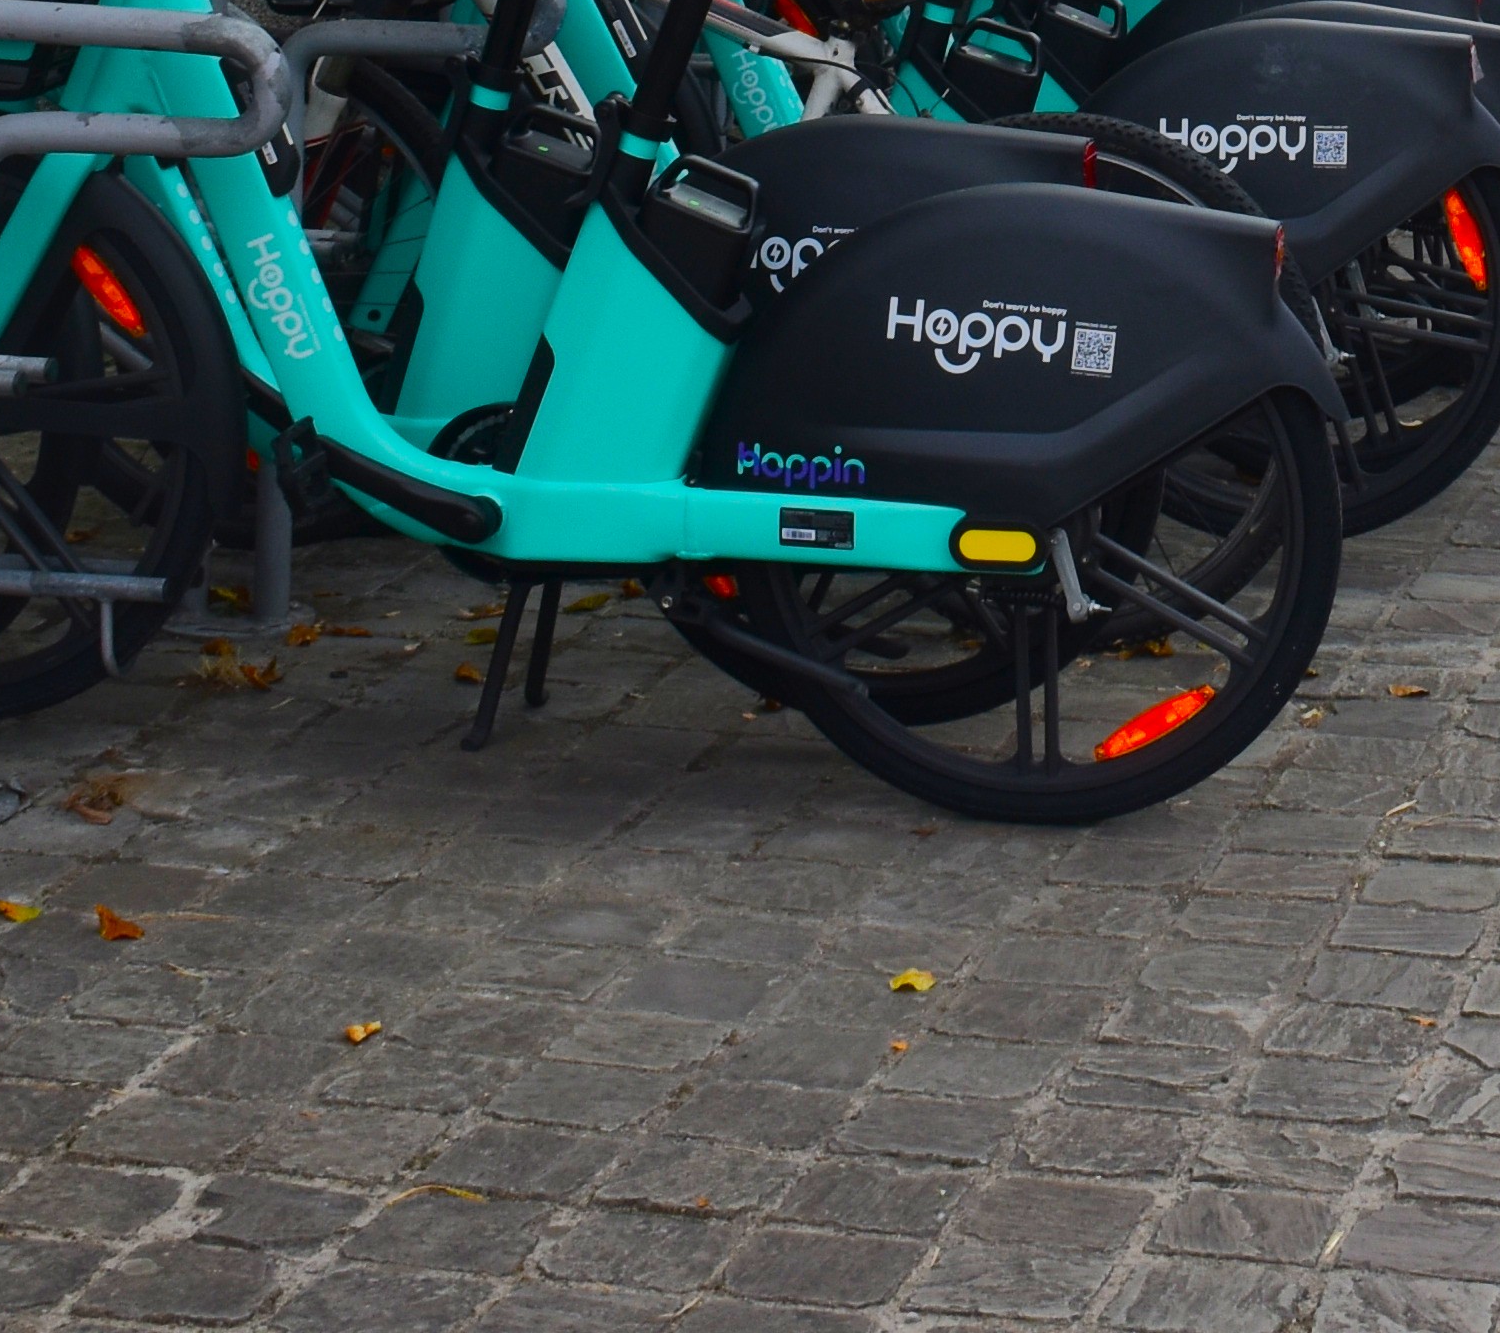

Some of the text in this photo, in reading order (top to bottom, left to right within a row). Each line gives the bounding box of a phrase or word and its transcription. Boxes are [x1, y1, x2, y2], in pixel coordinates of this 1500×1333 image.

[1160, 118, 1306, 161] Hoppy
[247, 232, 316, 359] Hoppy
[982, 299, 1004, 310] Don't
[1005, 303, 1028, 313] worry
[1029, 304, 1041, 313] be
[887, 296, 1067, 365] Hoppy
[737, 441, 865, 489] Hoppin
